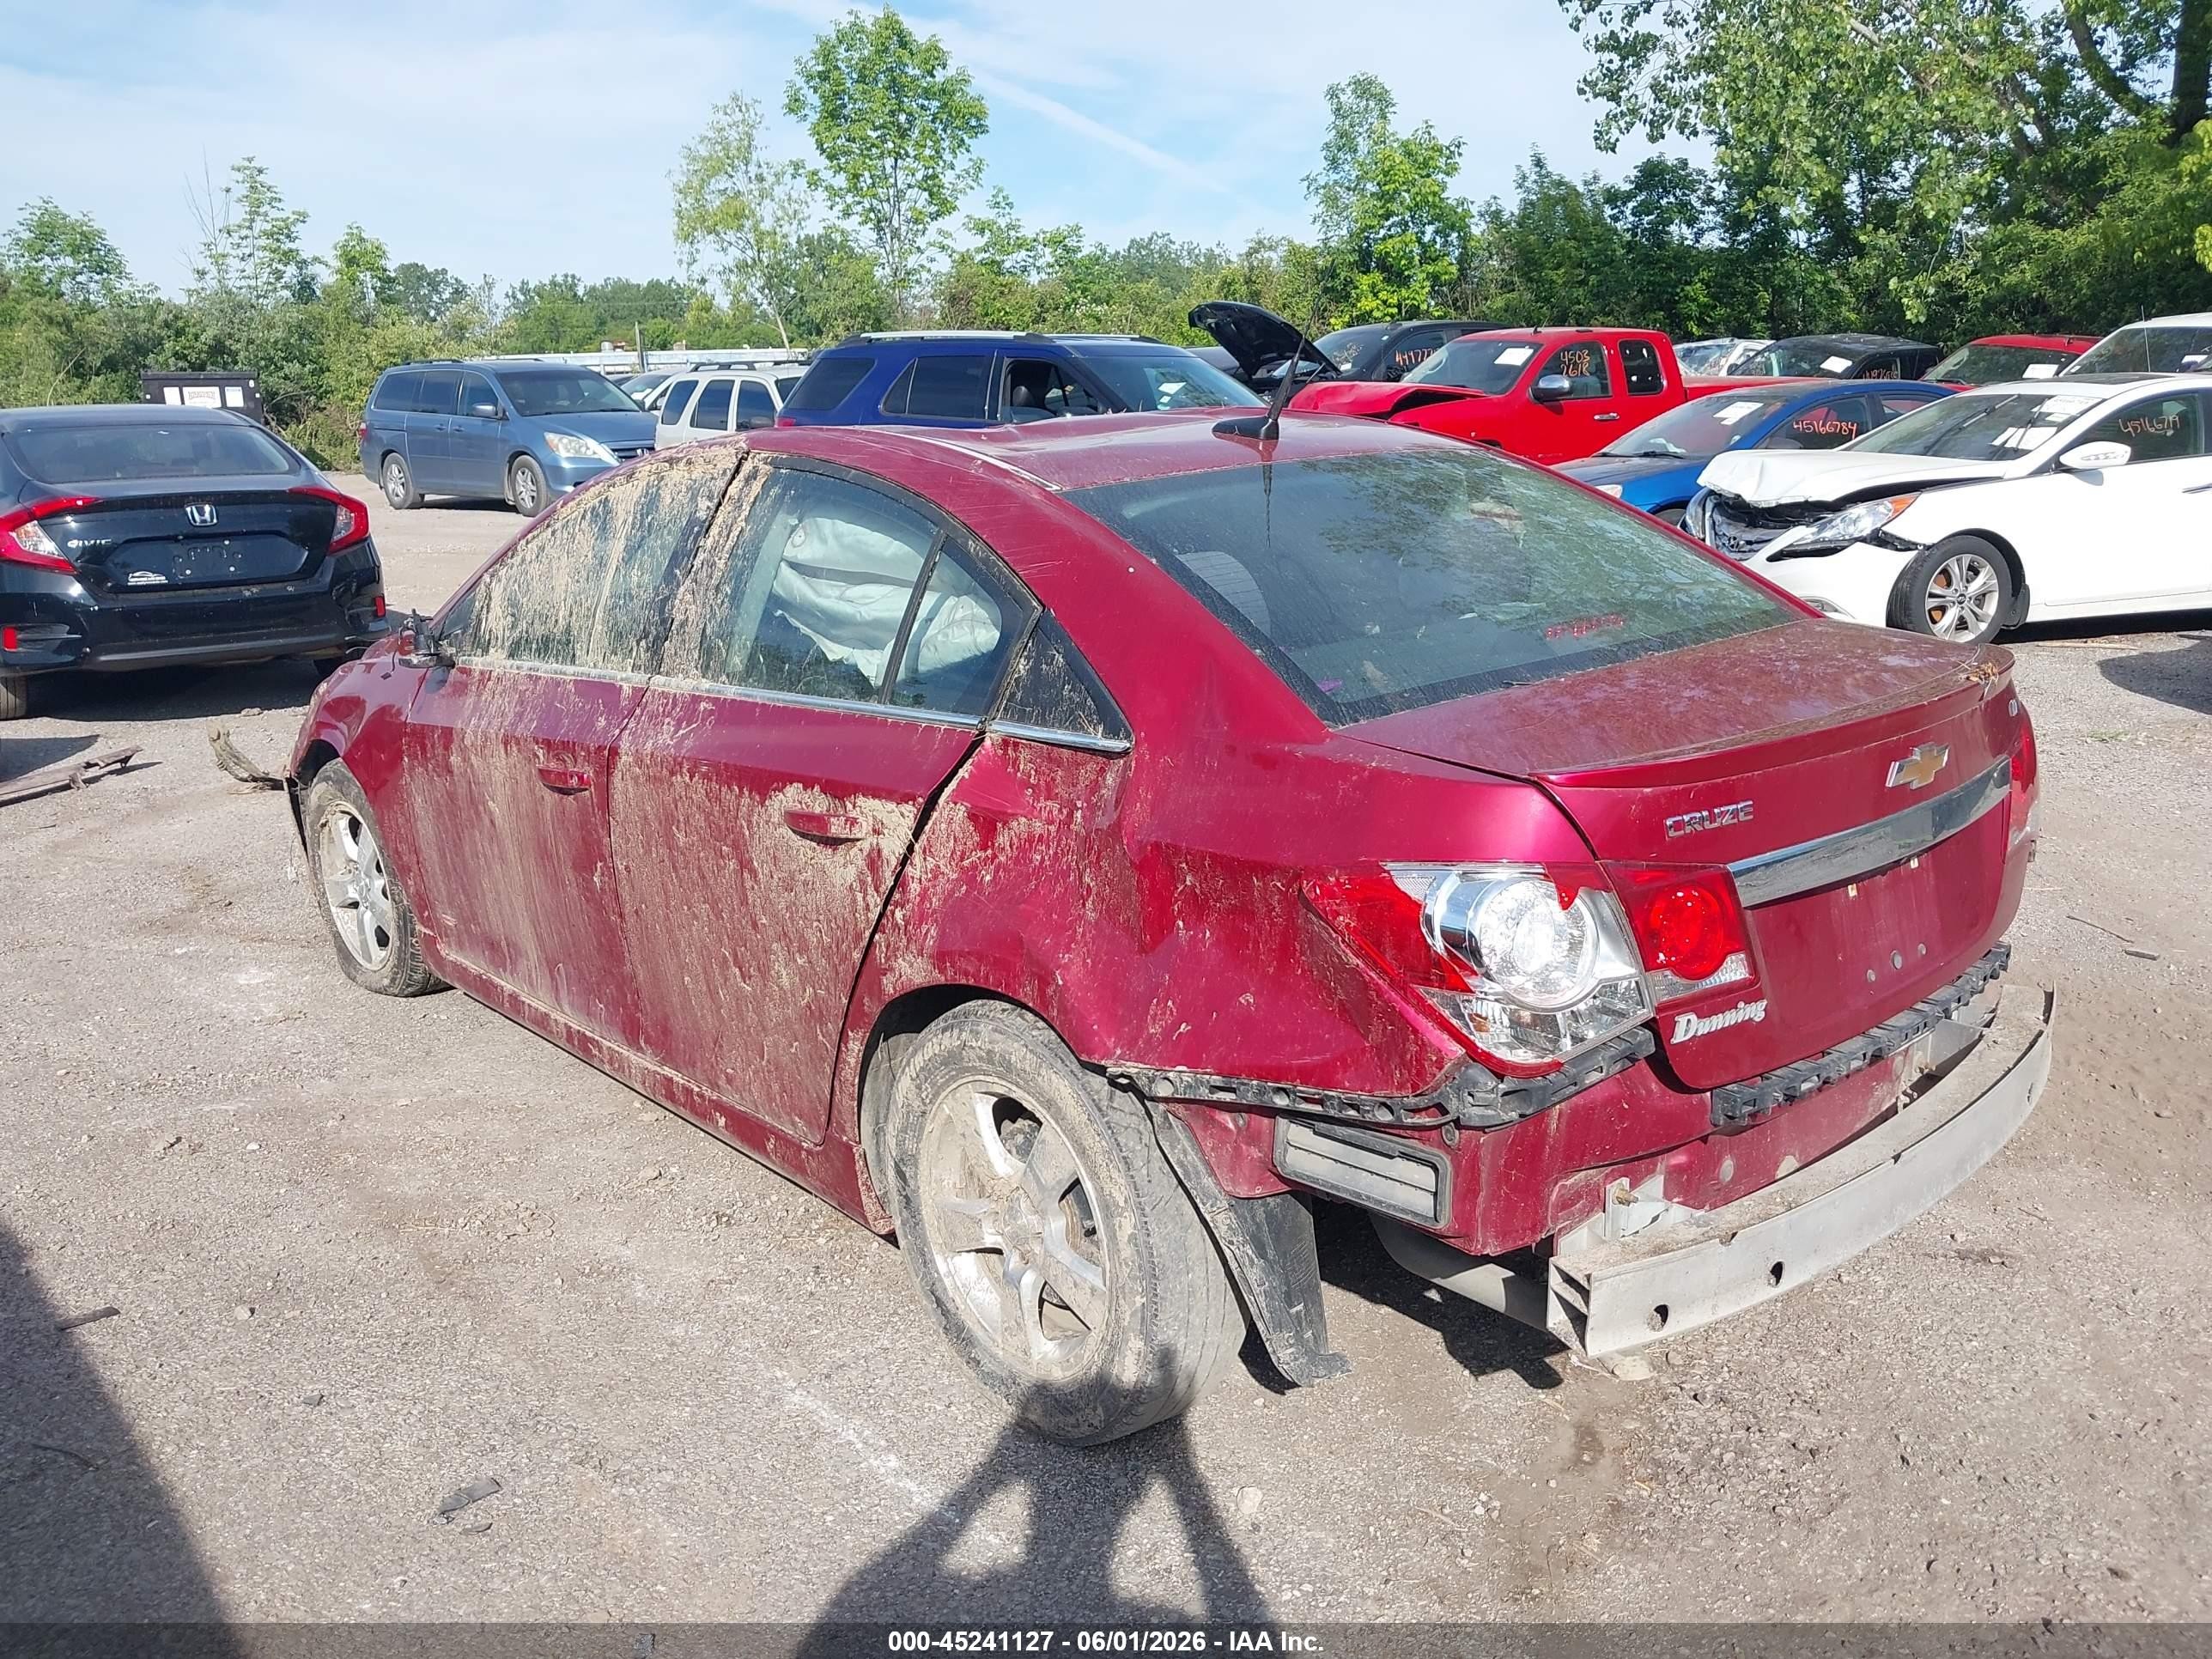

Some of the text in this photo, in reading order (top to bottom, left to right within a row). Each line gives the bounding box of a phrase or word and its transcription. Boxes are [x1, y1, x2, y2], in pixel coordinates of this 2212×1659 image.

[1560, 349, 1590, 365] 4503
[1560, 362, 1590, 377] 2618
[1793, 420, 1857, 441] 45166784
[1665, 799, 1754, 838] CRUZE
[1670, 999, 1768, 1045] Dunning
